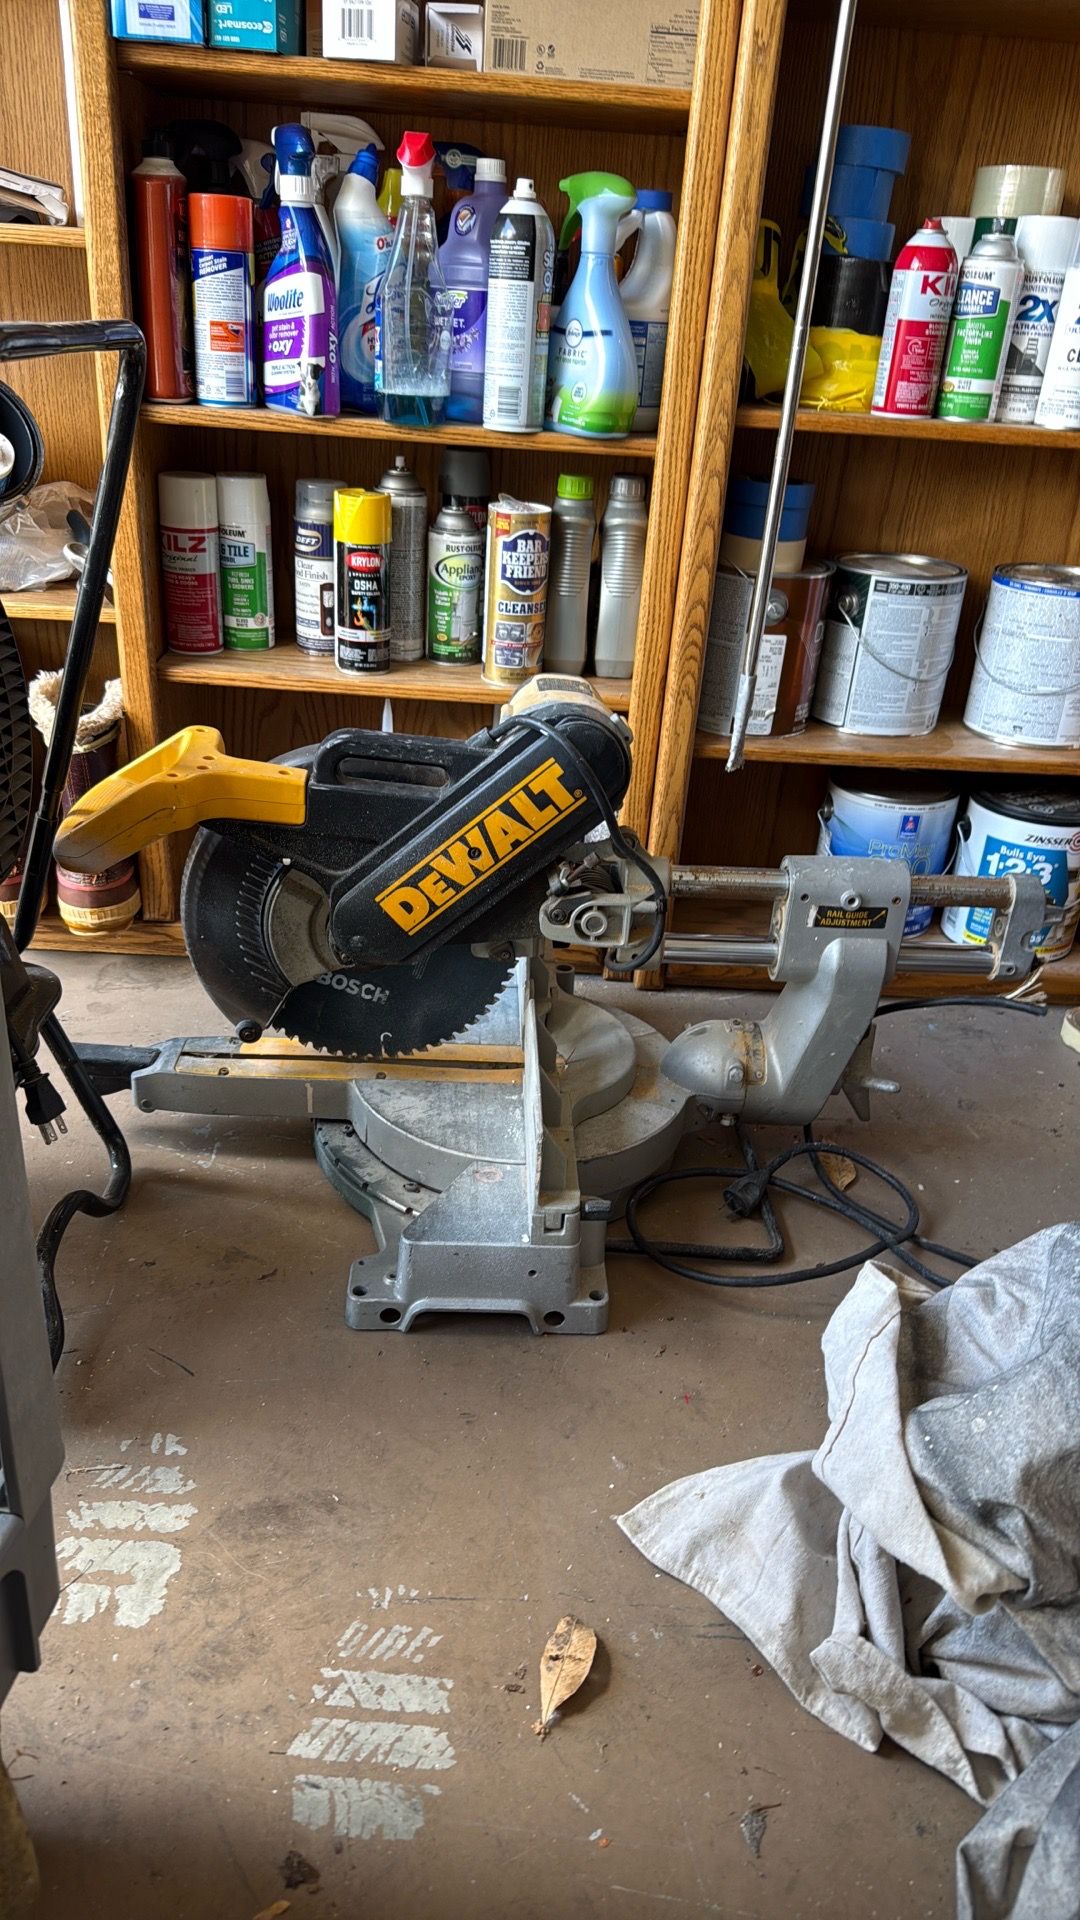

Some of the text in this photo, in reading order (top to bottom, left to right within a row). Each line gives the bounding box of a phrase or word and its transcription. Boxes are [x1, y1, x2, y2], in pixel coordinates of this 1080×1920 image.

[218, 19, 263, 31] ecosmart
[199, 262, 227, 276] REMOVER
[267, 289, 304, 312] Woolite
[958, 287, 995, 307] LIANCE
[1015, 295, 1059, 324] 2X
[272, 339, 293, 356] oxy
[328, 331, 338, 363] oxy
[558, 347, 584, 358] FABRIC
[296, 535, 319, 547] DEFT
[516, 540, 542, 554] BAR
[228, 546, 249, 558] TILE
[502, 552, 549, 566] KEEPERS
[297, 560, 313, 571] Clear
[351, 556, 381, 568] KRYLON
[305, 570, 328, 581] Finish
[440, 564, 481, 580] Applian
[505, 564, 547, 579] FRIEND
[354, 580, 378, 591] OSHA
[379, 762, 576, 932] DEWALT
[1024, 834, 1072, 846] ZINSSER
[1000, 845, 1046, 864] Bulls Eye
[827, 910, 869, 919] RAIL GUIDE
[820, 918, 873, 927] ADJUSTMENT
[316, 972, 390, 1005] BOSCH
